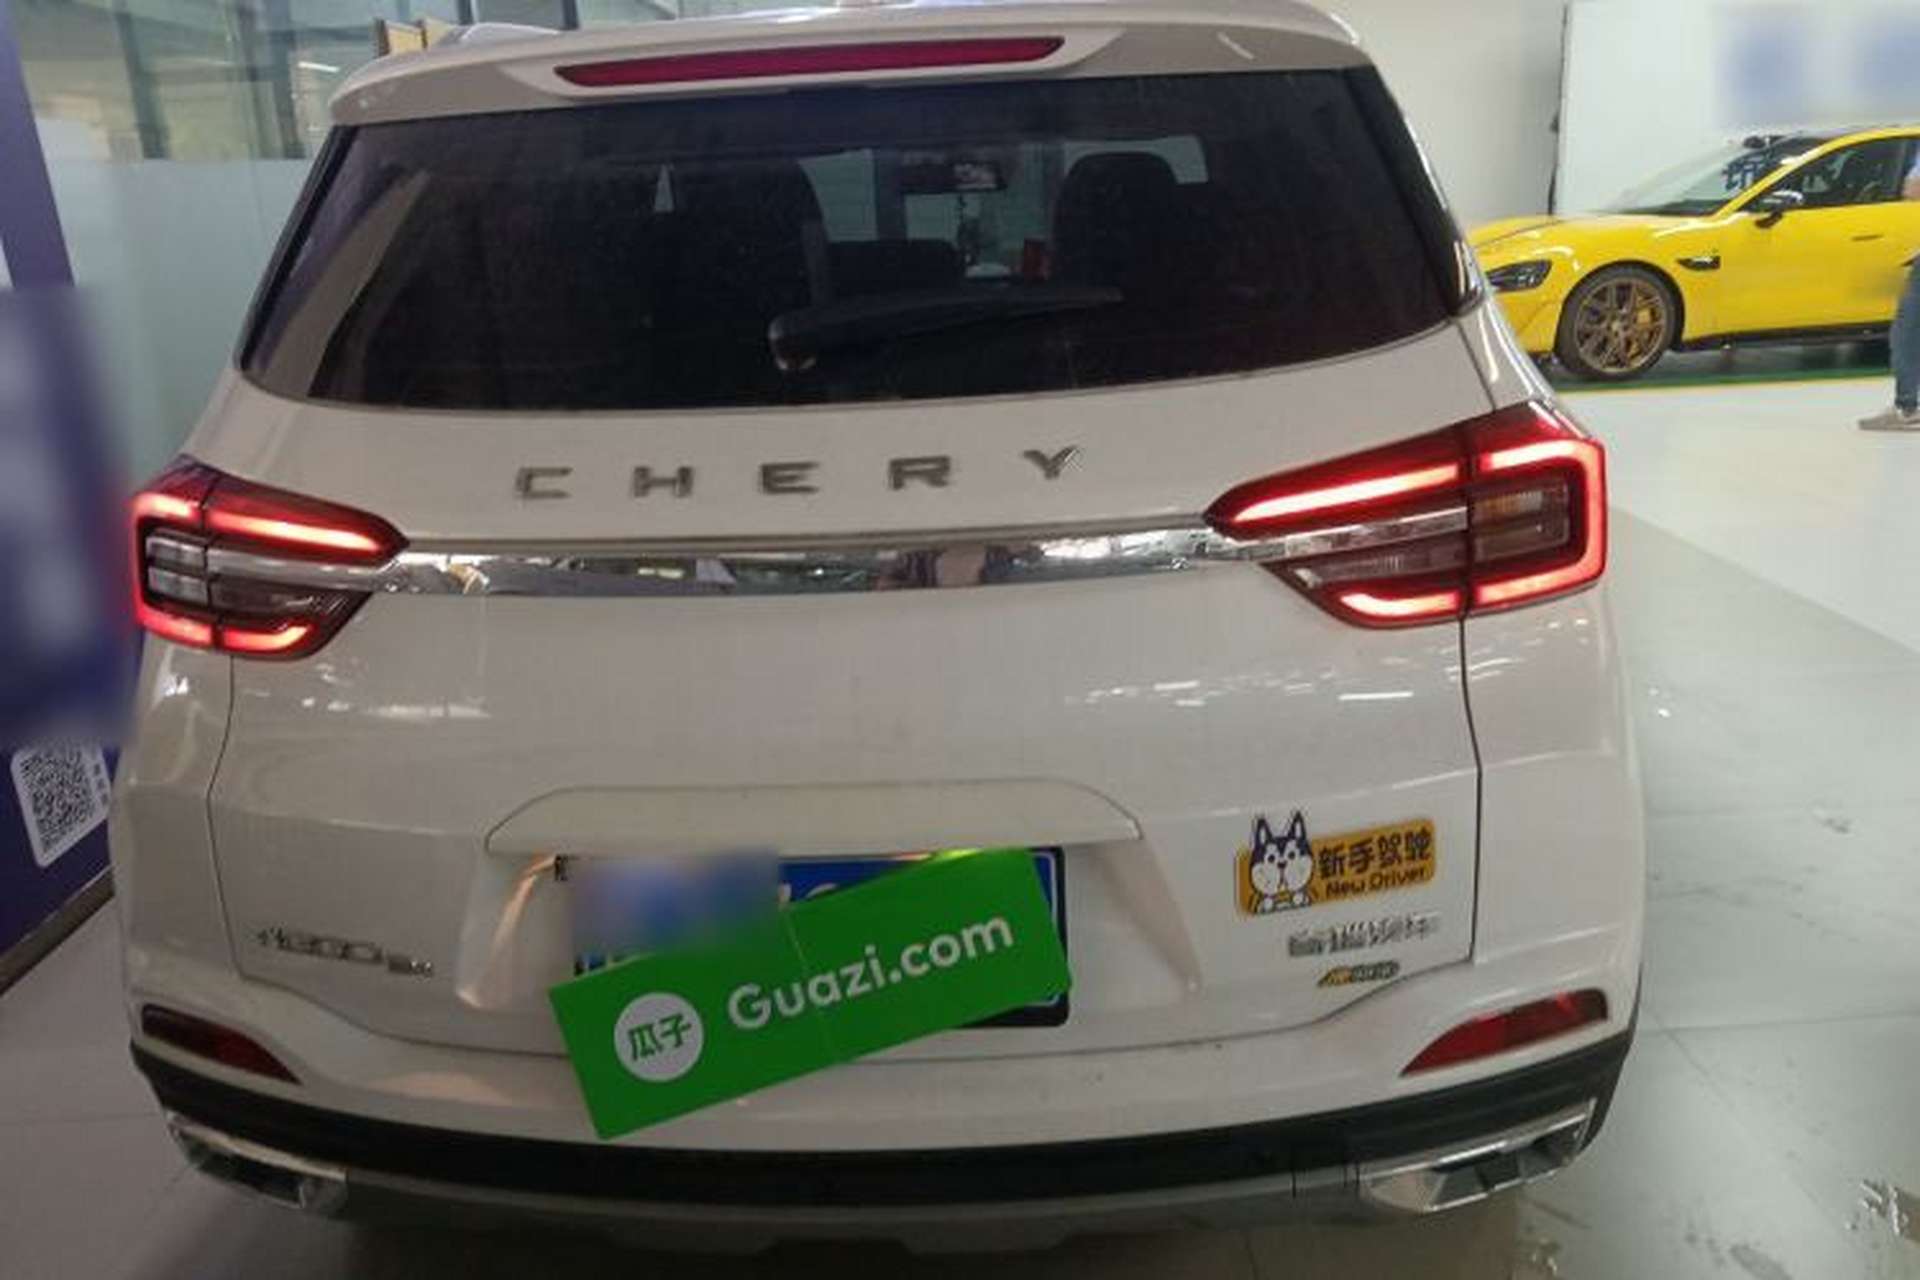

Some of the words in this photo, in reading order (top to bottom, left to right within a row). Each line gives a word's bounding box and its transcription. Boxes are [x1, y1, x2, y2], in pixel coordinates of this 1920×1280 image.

[514, 444, 1084, 500] CHERY
[1369, 867, 1424, 890] Driver
[727, 915, 1015, 1030] Guazi.com
[627, 1013, 692, 1063] 瓜子
